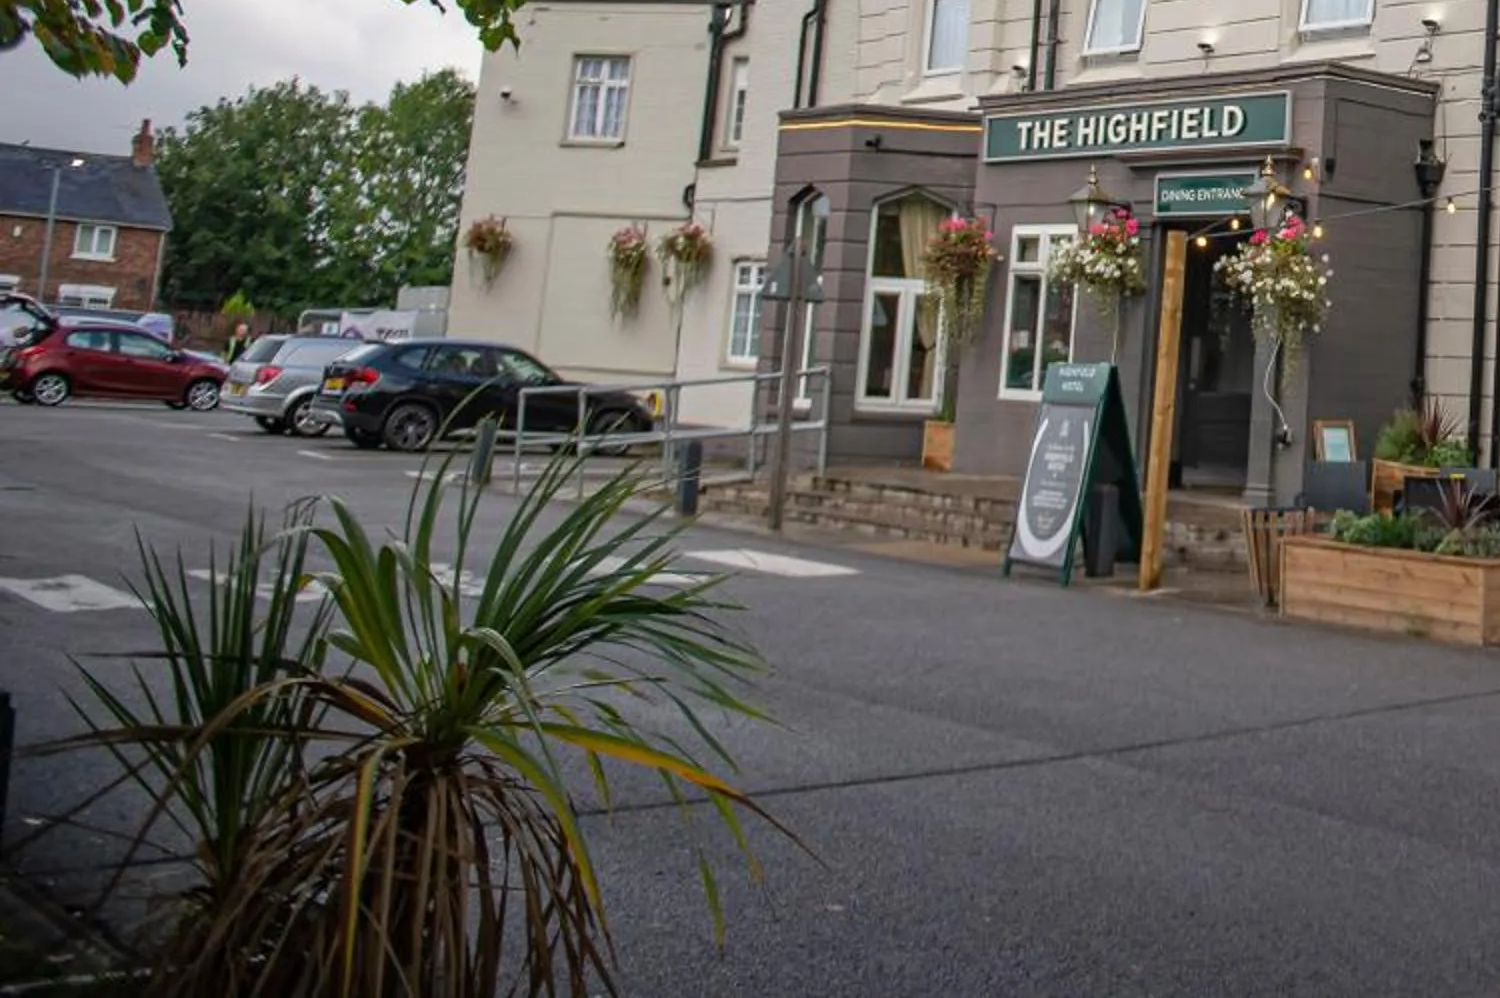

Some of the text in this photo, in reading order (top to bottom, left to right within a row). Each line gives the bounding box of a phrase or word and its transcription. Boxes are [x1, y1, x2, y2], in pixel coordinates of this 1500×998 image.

[1016, 105, 1245, 150] THE HIGHFIELD
[1161, 187, 1247, 202] DINING ENTRANC
